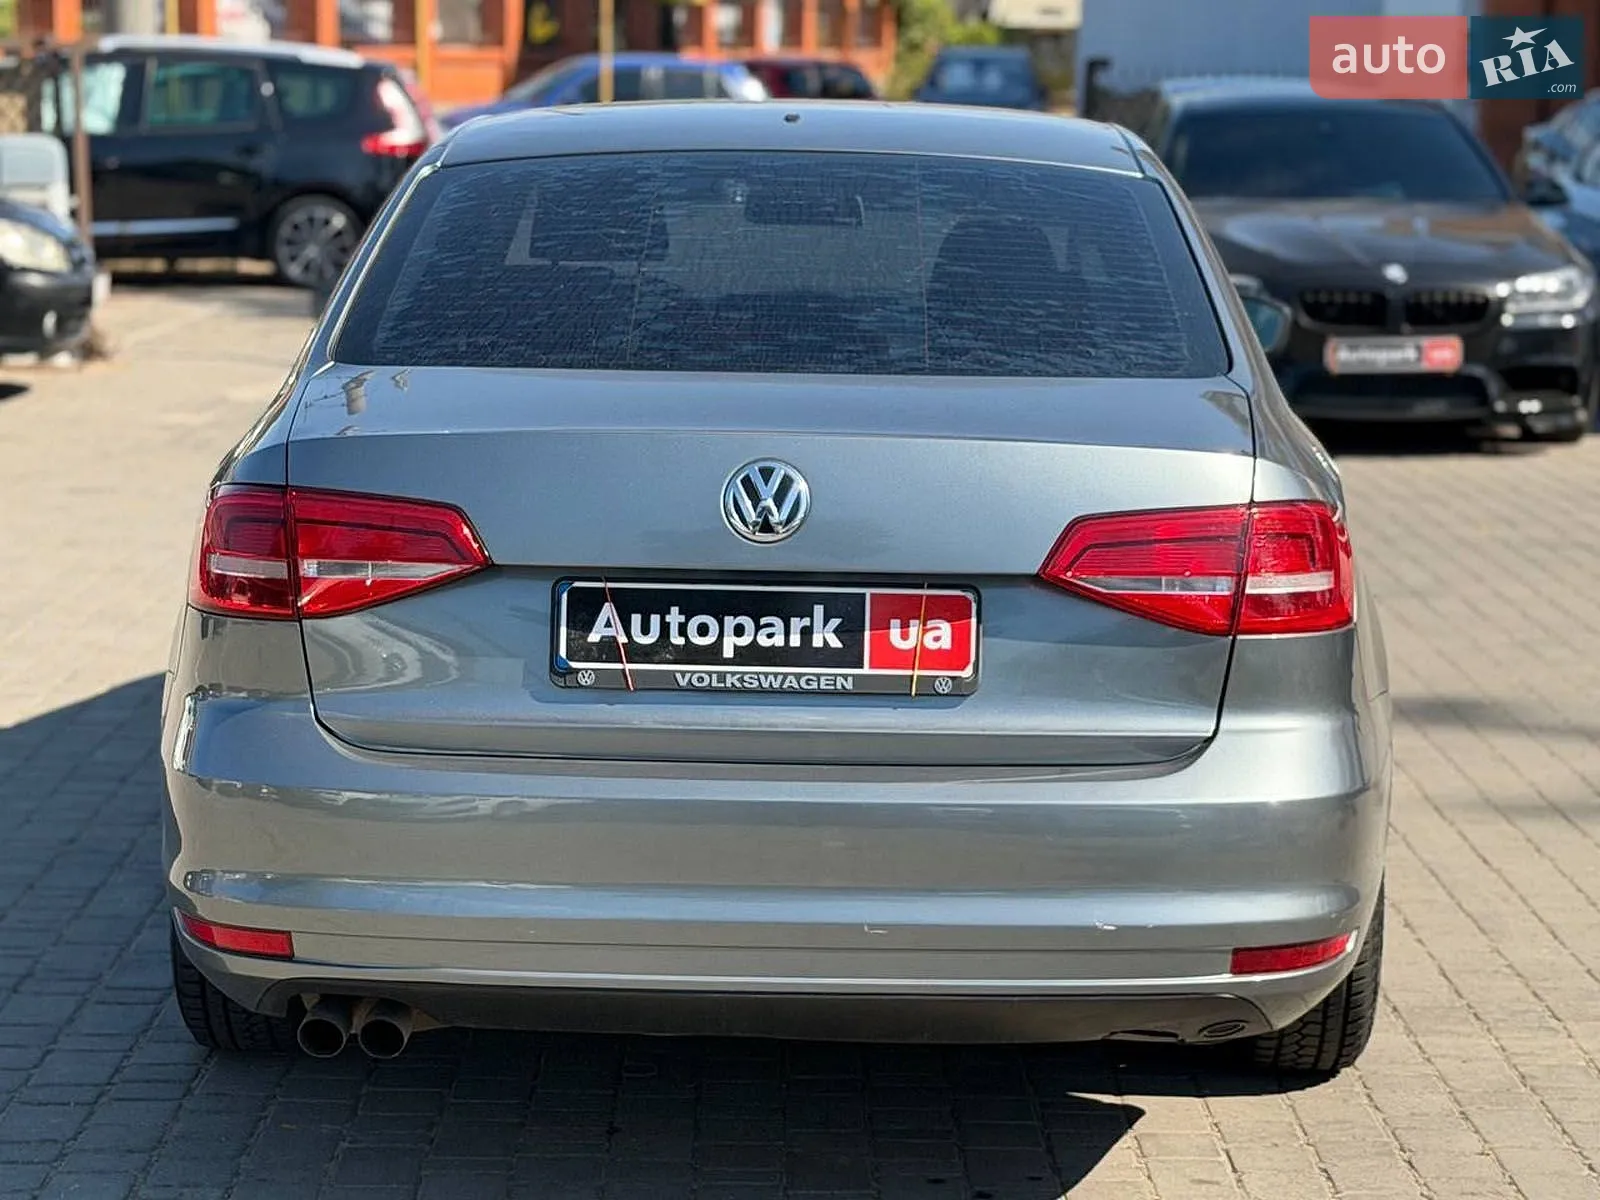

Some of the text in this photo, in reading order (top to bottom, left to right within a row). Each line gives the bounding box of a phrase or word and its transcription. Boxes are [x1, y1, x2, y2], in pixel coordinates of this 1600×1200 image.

[587, 602, 952, 658] Autopark ua
[674, 672, 854, 691] VOLKSWAGEN
